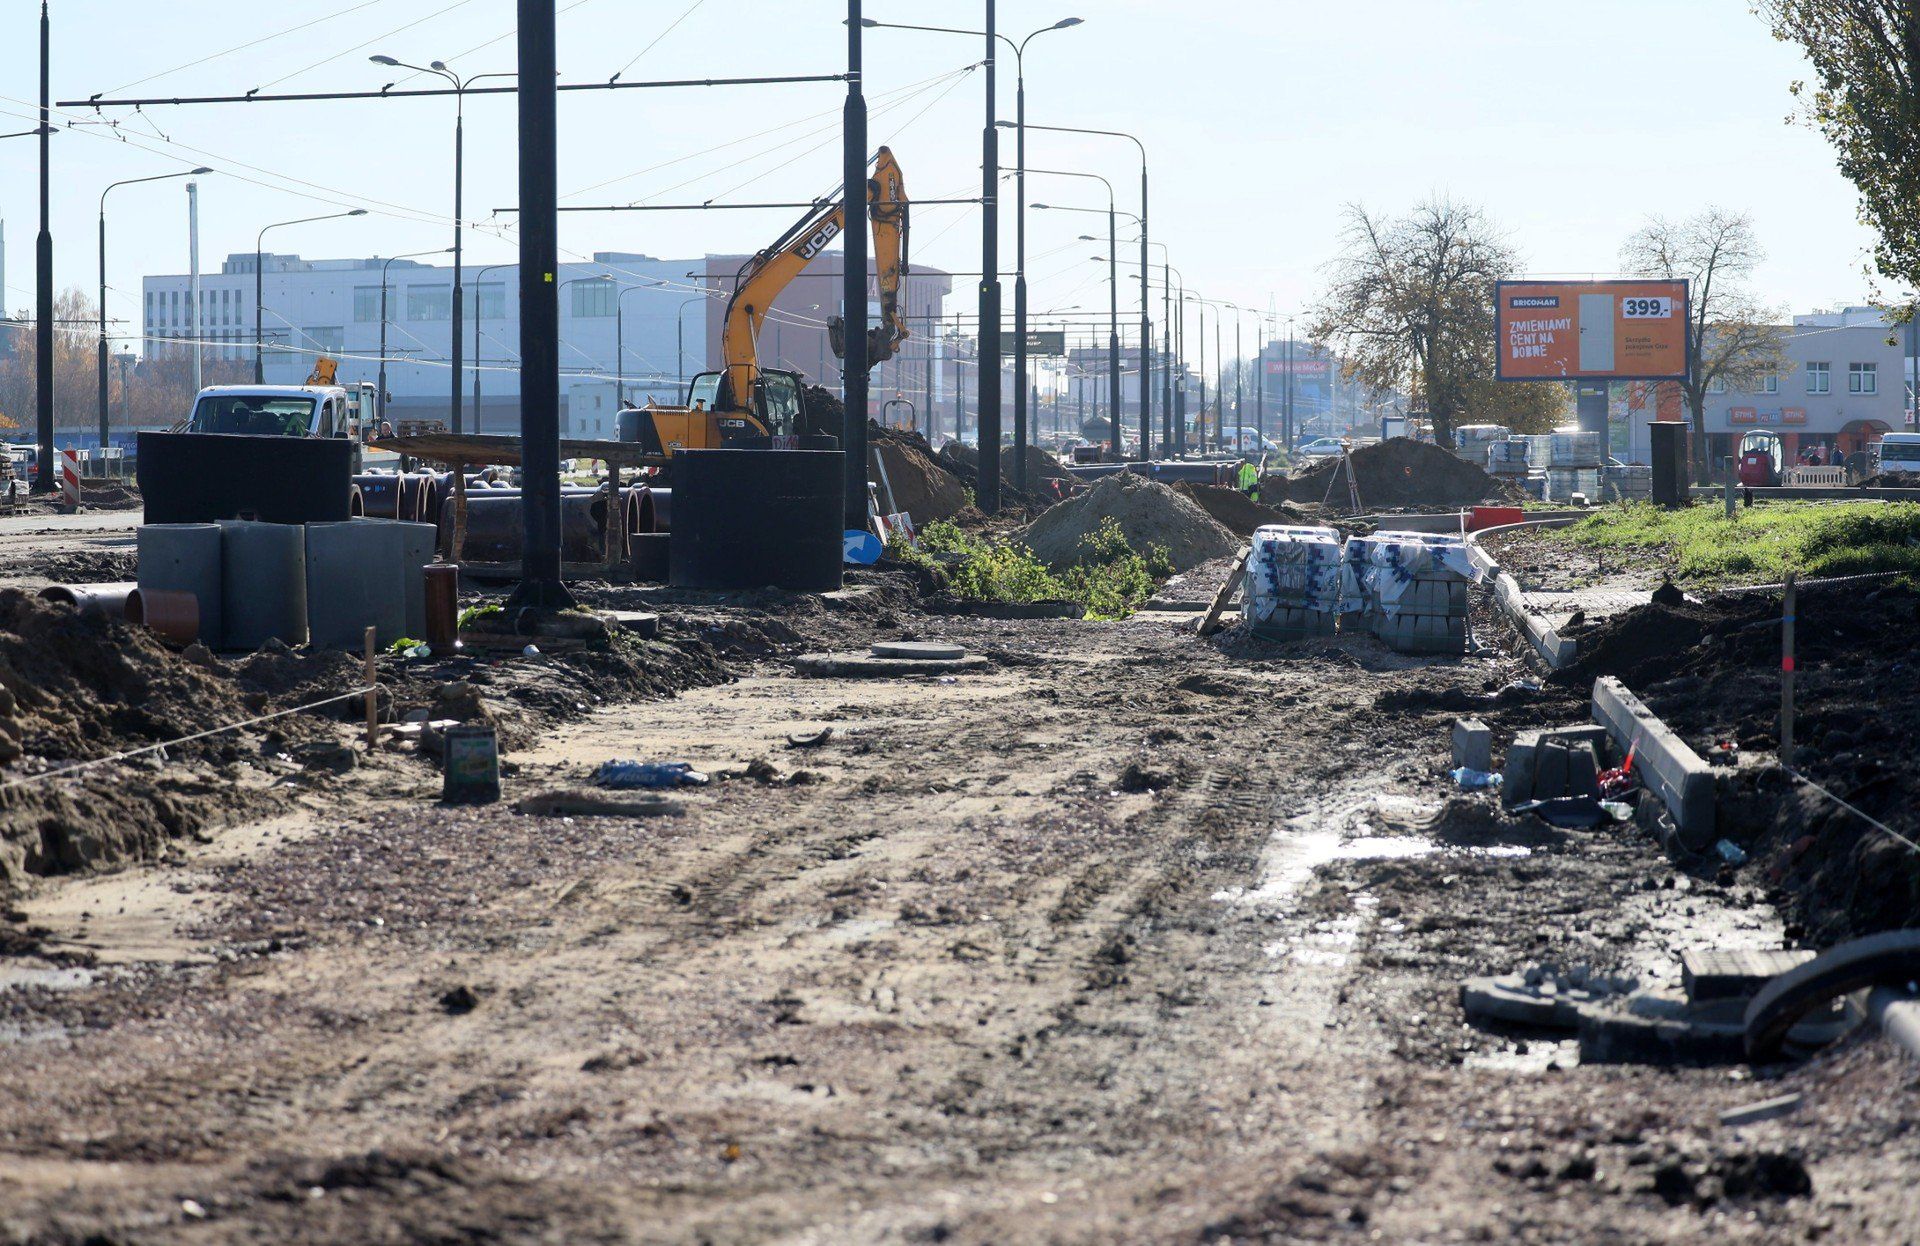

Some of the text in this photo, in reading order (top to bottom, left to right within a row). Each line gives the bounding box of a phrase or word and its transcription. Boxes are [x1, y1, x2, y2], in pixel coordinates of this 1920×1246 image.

[803, 221, 839, 259] JCB
[1626, 299, 1669, 317] 399,-
[1509, 317, 1572, 334] ZMIENIAMY
[1510, 332, 1555, 346] CENY NA
[1512, 345, 1548, 359] DOBRE
[1734, 410, 1754, 419] STIHL
[719, 420, 745, 428] JCB
